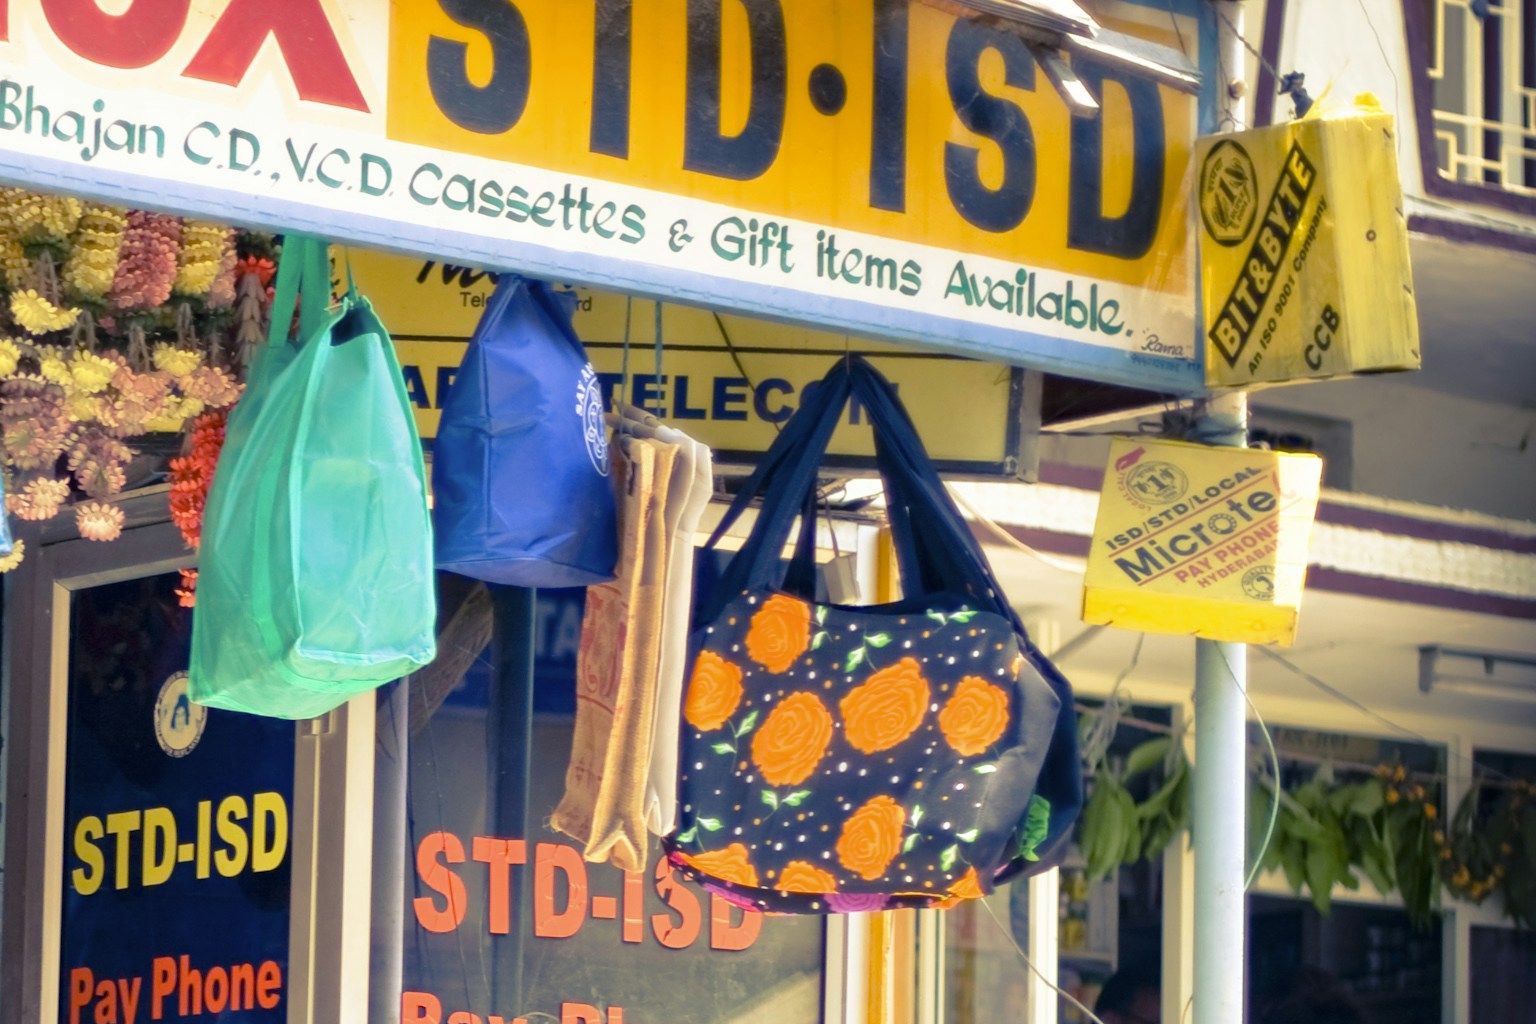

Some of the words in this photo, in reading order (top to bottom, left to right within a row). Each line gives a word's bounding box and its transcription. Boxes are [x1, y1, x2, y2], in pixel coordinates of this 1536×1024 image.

[409, 162, 647, 244] Cassettes
[668, 217, 694, 253] &
[710, 216, 796, 274] Gift
[815, 228, 923, 297] items
[943, 259, 1134, 338] Available.
[1214, 150, 1312, 358] BIT&BYTE
[1248, 352, 1262, 376] An
[1260, 318, 1277, 349] ISO
[1274, 275, 1295, 316] 9001
[1292, 195, 1328, 272] Company
[1304, 304, 1340, 371] CCB
[1105, 465, 1262, 550] ISD/STD/LOCAL
[1173, 556, 1214, 583] PAY
[1196, 538, 1280, 589] HYDERABA
[71, 791, 289, 896] STD-ISD
[413, 831, 763, 951] STD-ISD
[151, 954, 282, 1020] Phone
